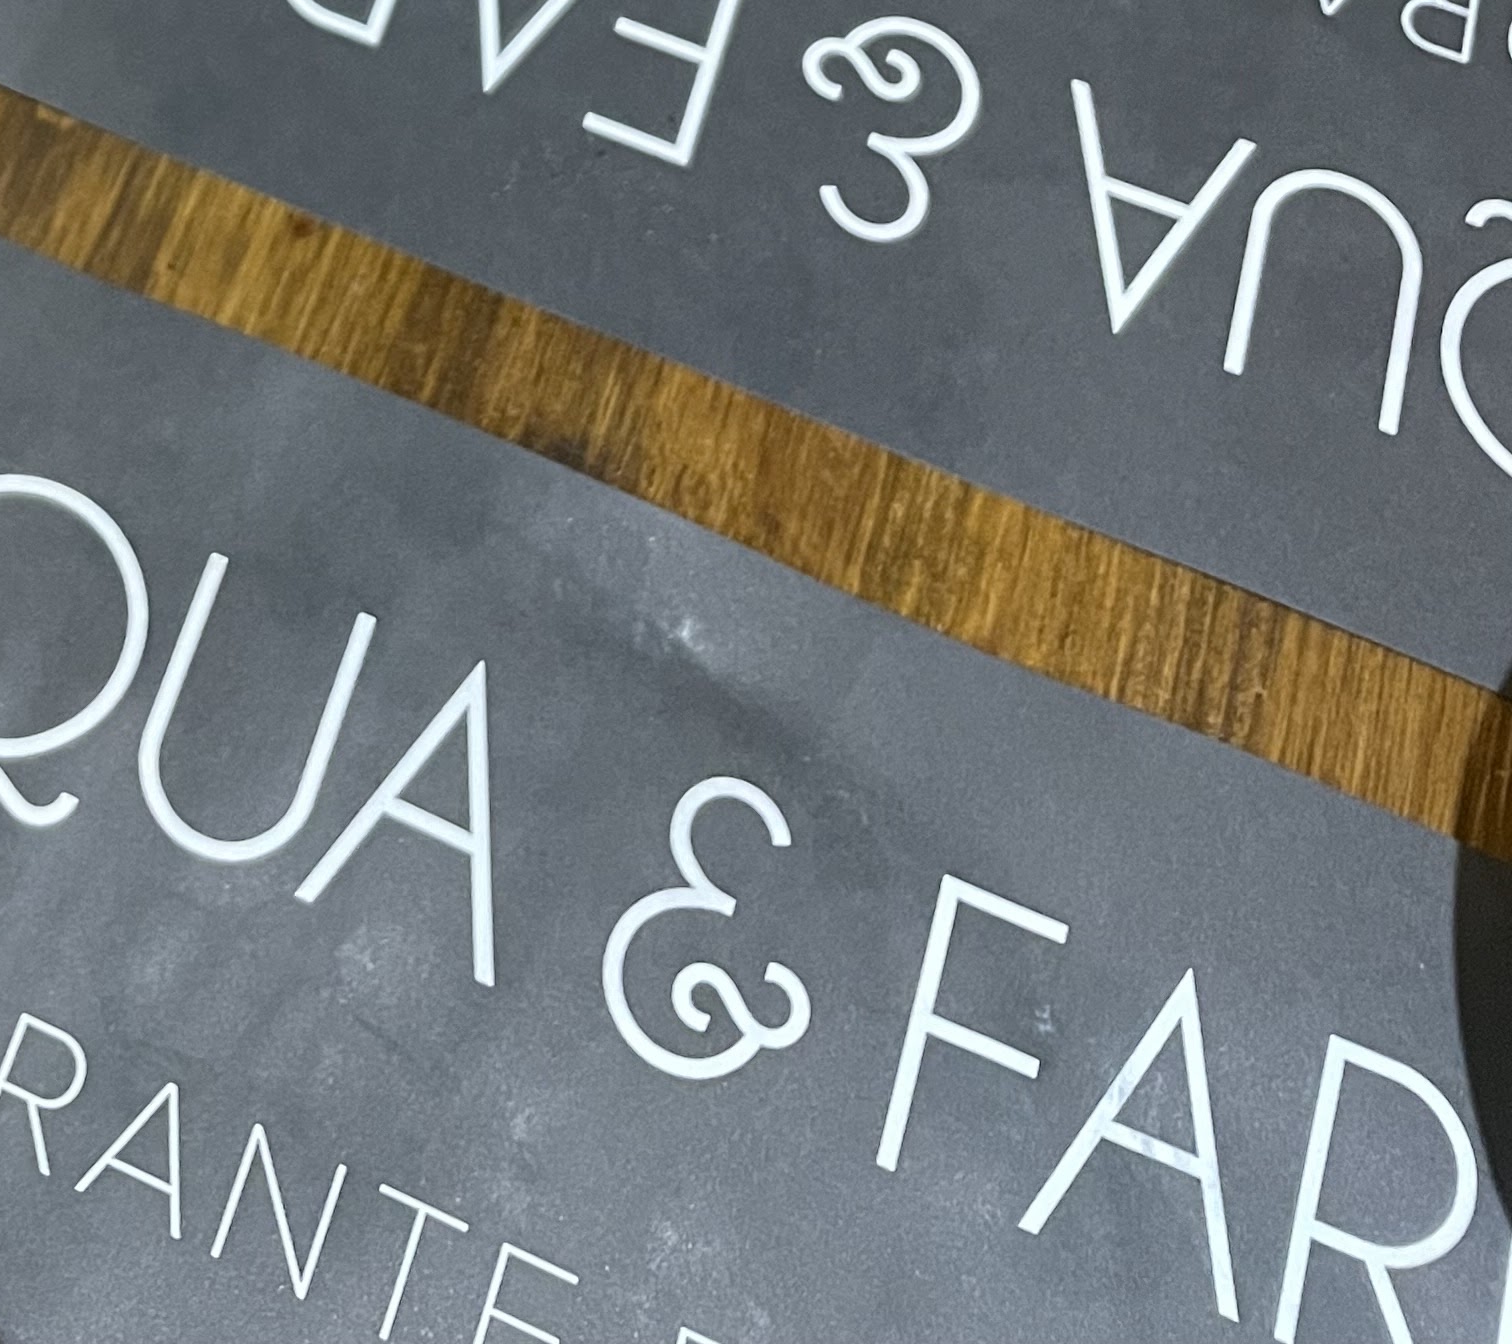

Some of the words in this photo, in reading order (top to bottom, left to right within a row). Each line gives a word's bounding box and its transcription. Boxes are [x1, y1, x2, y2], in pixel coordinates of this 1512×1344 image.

[801, 16, 982, 243] &
[602, 776, 811, 1080] &
[875, 873, 1512, 1344] FAR
